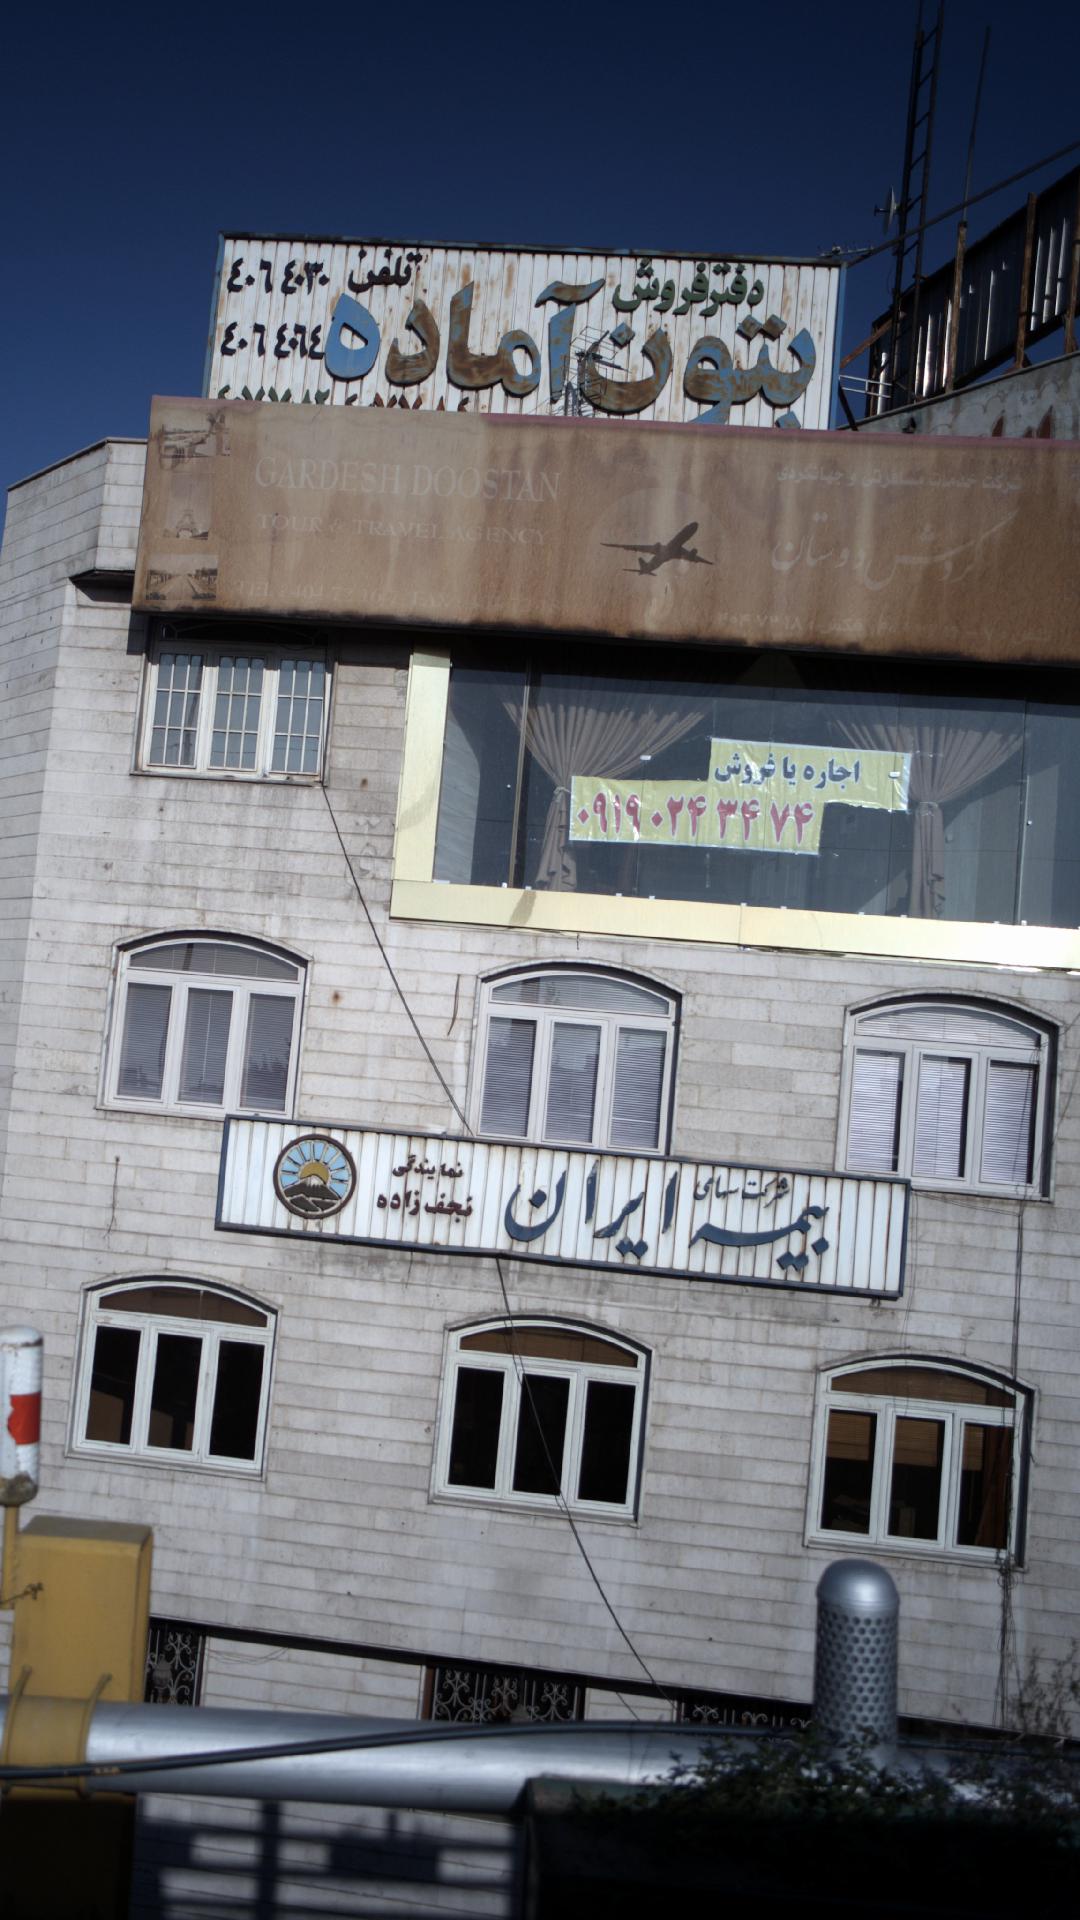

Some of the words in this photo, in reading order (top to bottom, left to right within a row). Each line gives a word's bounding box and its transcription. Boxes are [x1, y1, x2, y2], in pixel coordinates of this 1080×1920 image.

[348, 249, 418, 293] تلفن
[324, 278, 606, 404] آماده
[255, 456, 401, 496] GARDESH
[412, 463, 560, 502] DOOSTAN
[256, 512, 323, 533] TOUR
[352, 518, 442, 540] TRAVEL
[449, 525, 551, 546] AGENCY
[714, 752, 776, 786] فروش
[782, 756, 796, 786] یا
[803, 759, 861, 789] اجاره
[392, 1154, 464, 1181] نمایندگی
[377, 1189, 420, 1216] زاده
[424, 1192, 473, 1223] نجف
[504, 1159, 678, 1260] ایران
[742, 1177, 791, 1209] شرکت
[689, 1204, 830, 1272] بیمه
